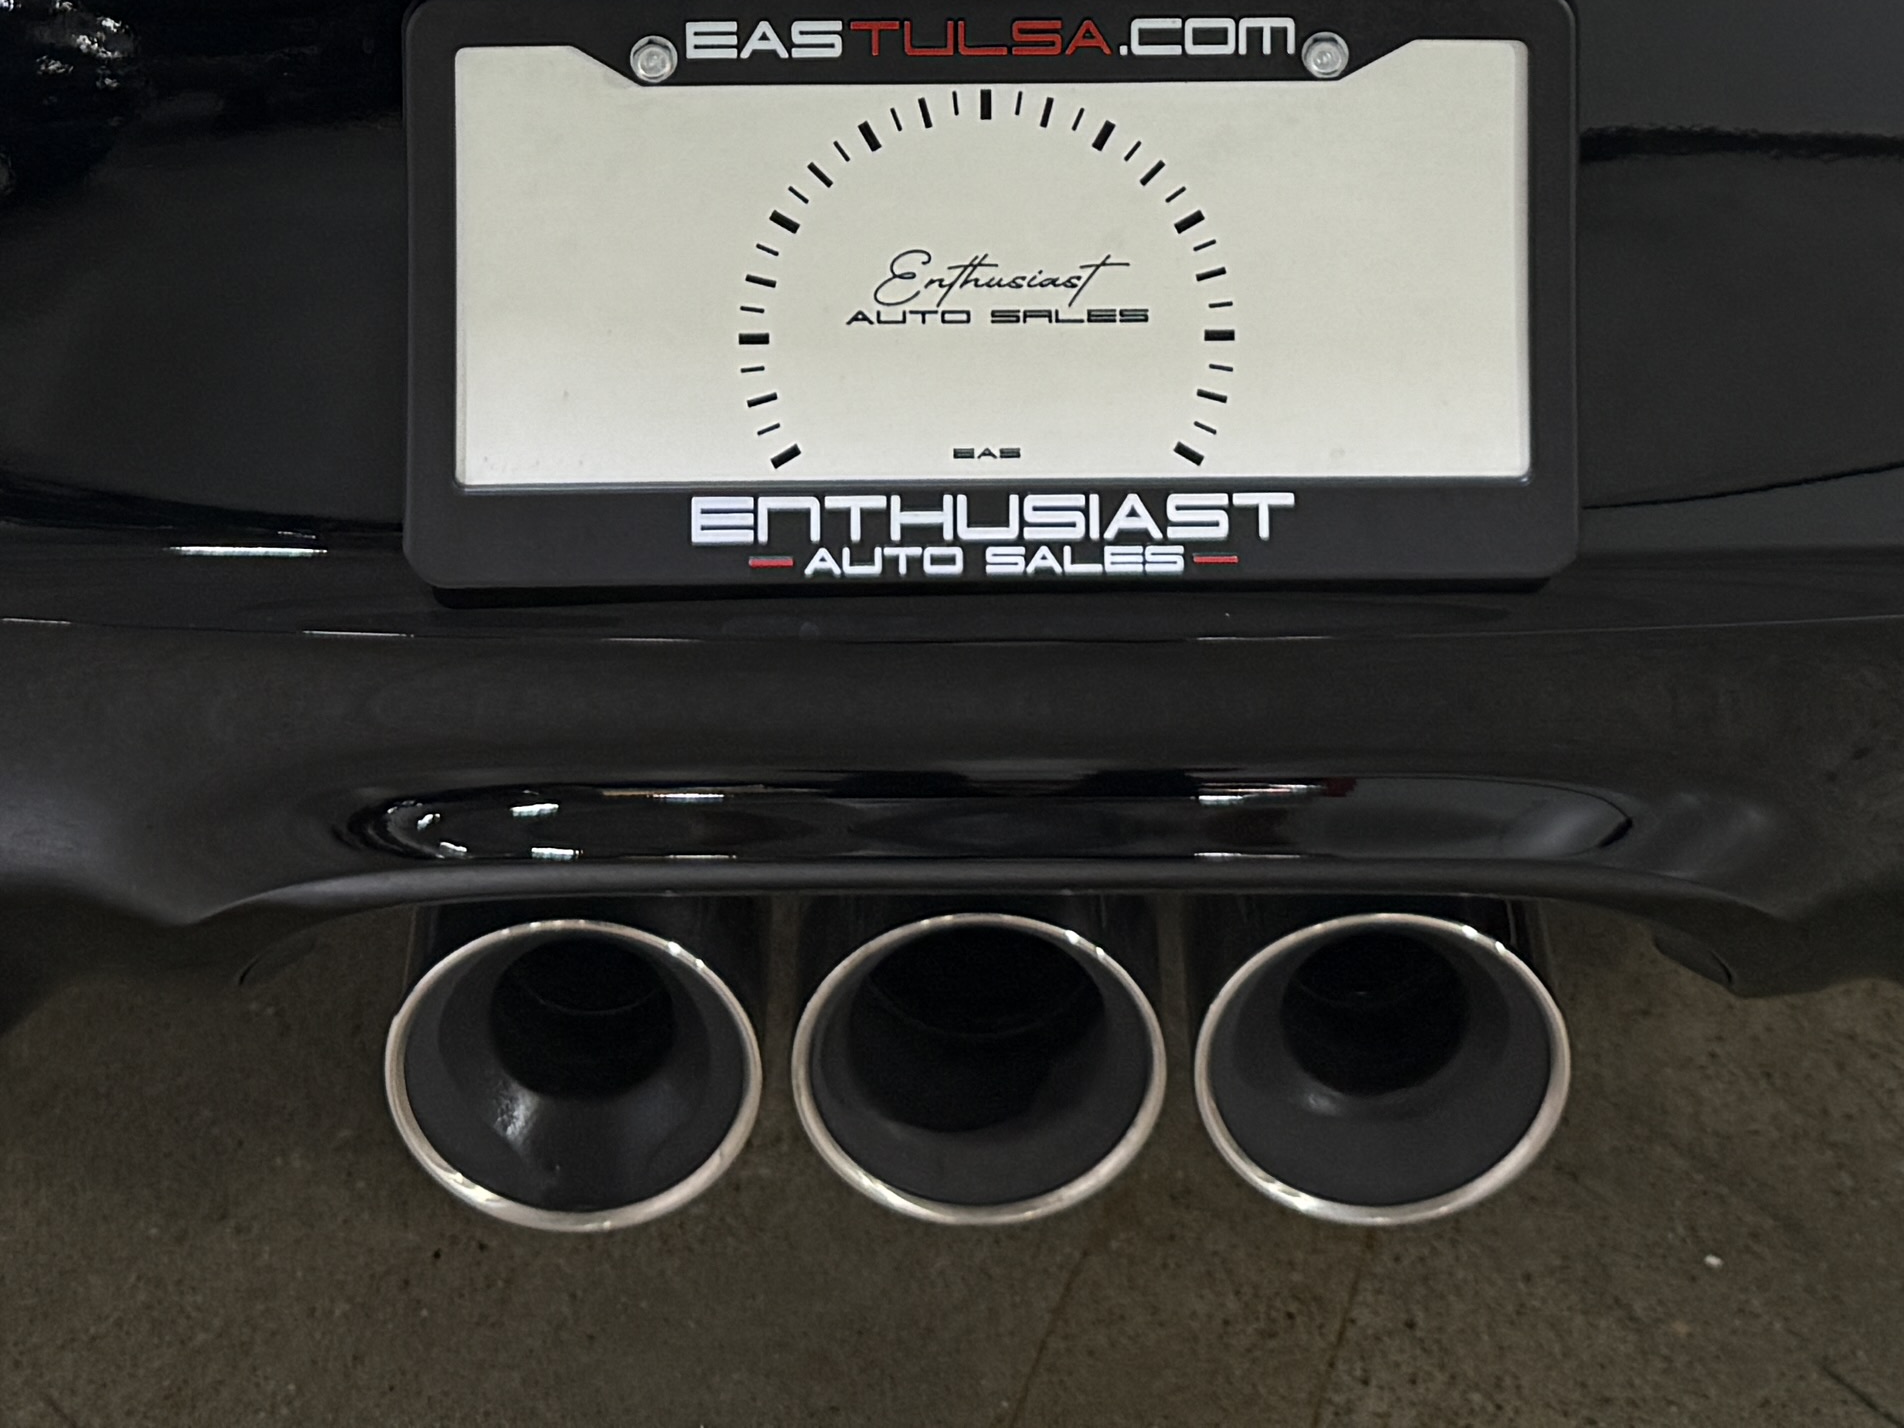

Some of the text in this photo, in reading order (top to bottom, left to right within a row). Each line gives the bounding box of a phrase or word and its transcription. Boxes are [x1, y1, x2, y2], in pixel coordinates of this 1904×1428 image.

[684, 16, 1296, 60] EASTULSA.COM
[873, 248, 1131, 308] Enthusiast
[845, 307, 1150, 326] AUTO SALES
[952, 447, 1022, 460] EAS
[690, 491, 1295, 544] ENTHUSIAST
[803, 544, 1186, 576] AUTO SALES
